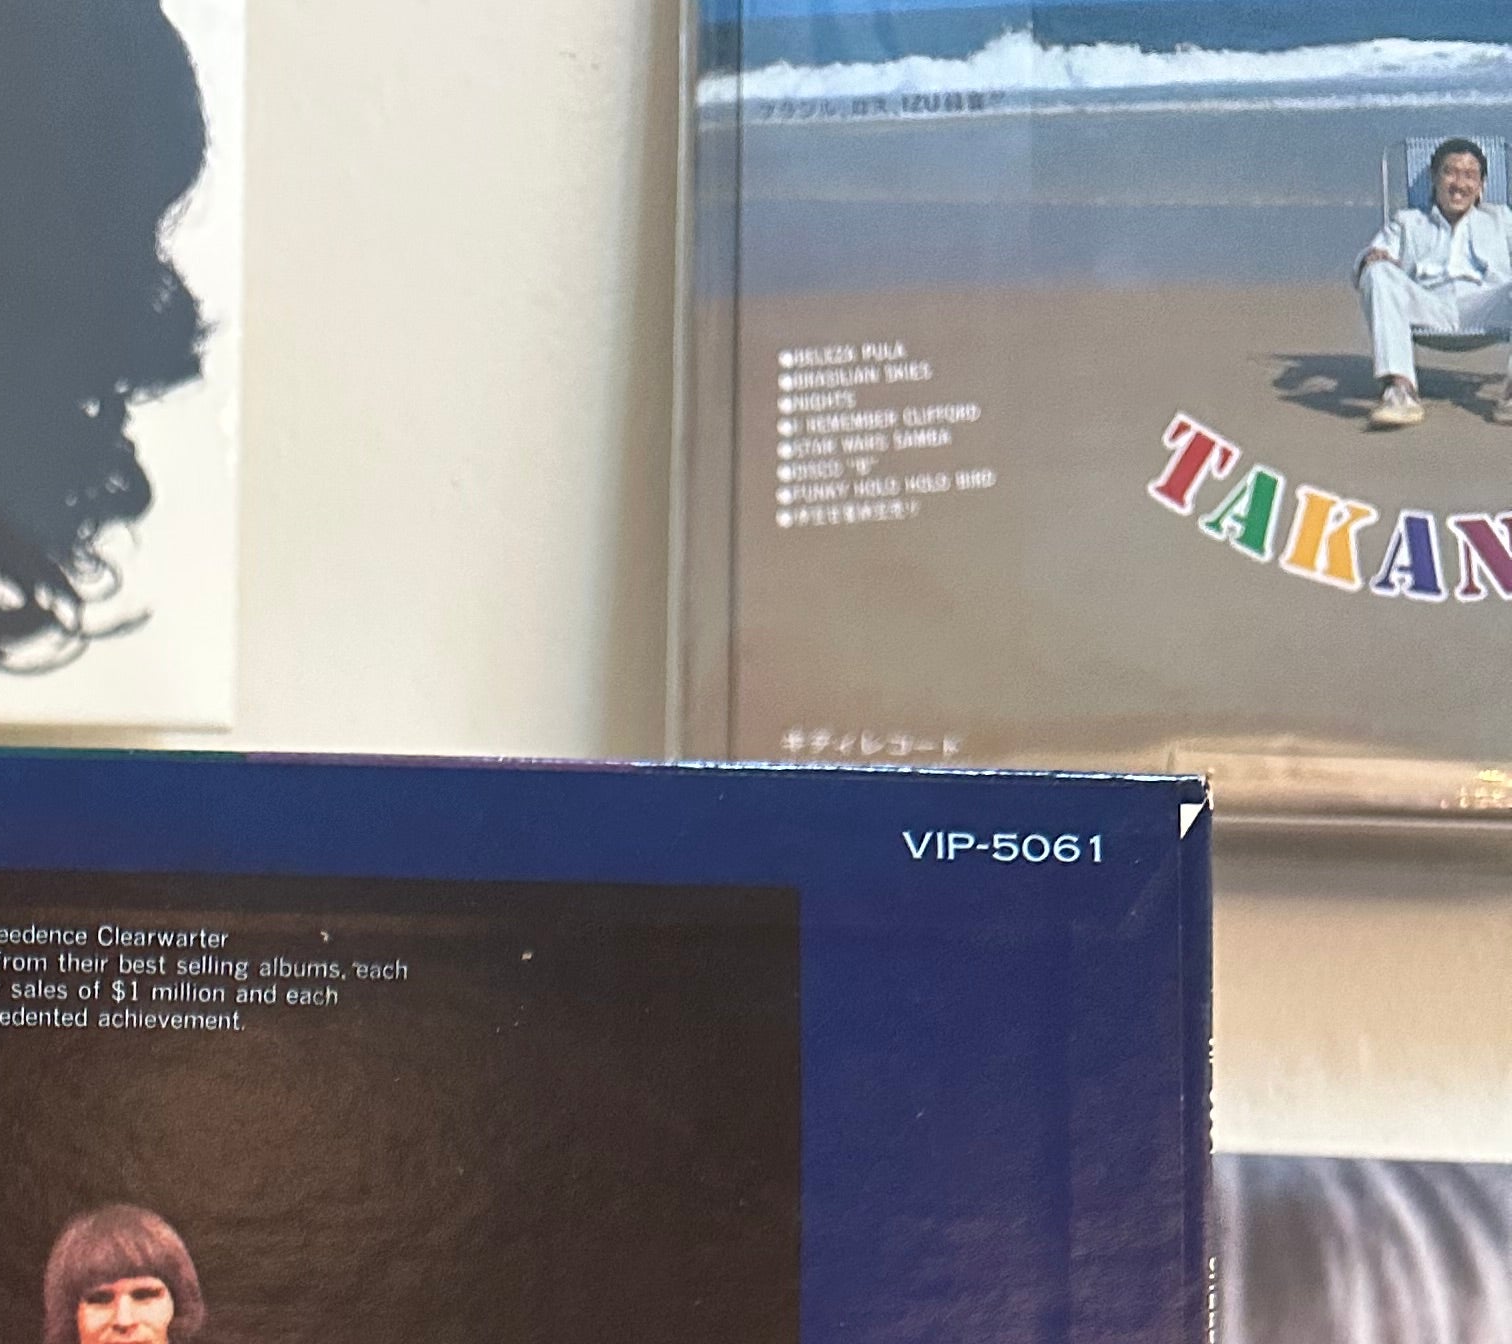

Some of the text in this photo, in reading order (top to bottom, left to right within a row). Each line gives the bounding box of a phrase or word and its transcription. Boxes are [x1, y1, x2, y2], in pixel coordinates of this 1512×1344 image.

[902, 831, 1102, 863] VIP-5061
[97, 925, 229, 949] Clearwarter
[58, 952, 109, 973] their
[119, 953, 166, 975] best
[177, 955, 249, 981] selling
[355, 959, 408, 980] each
[11, 979, 68, 1000] sales
[78, 980, 100, 1000] of
[111, 979, 138, 1004] $1
[152, 982, 225, 1003] million
[236, 984, 277, 1004] and
[286, 986, 338, 1005] each
[98, 1008, 246, 1031] achievement.
